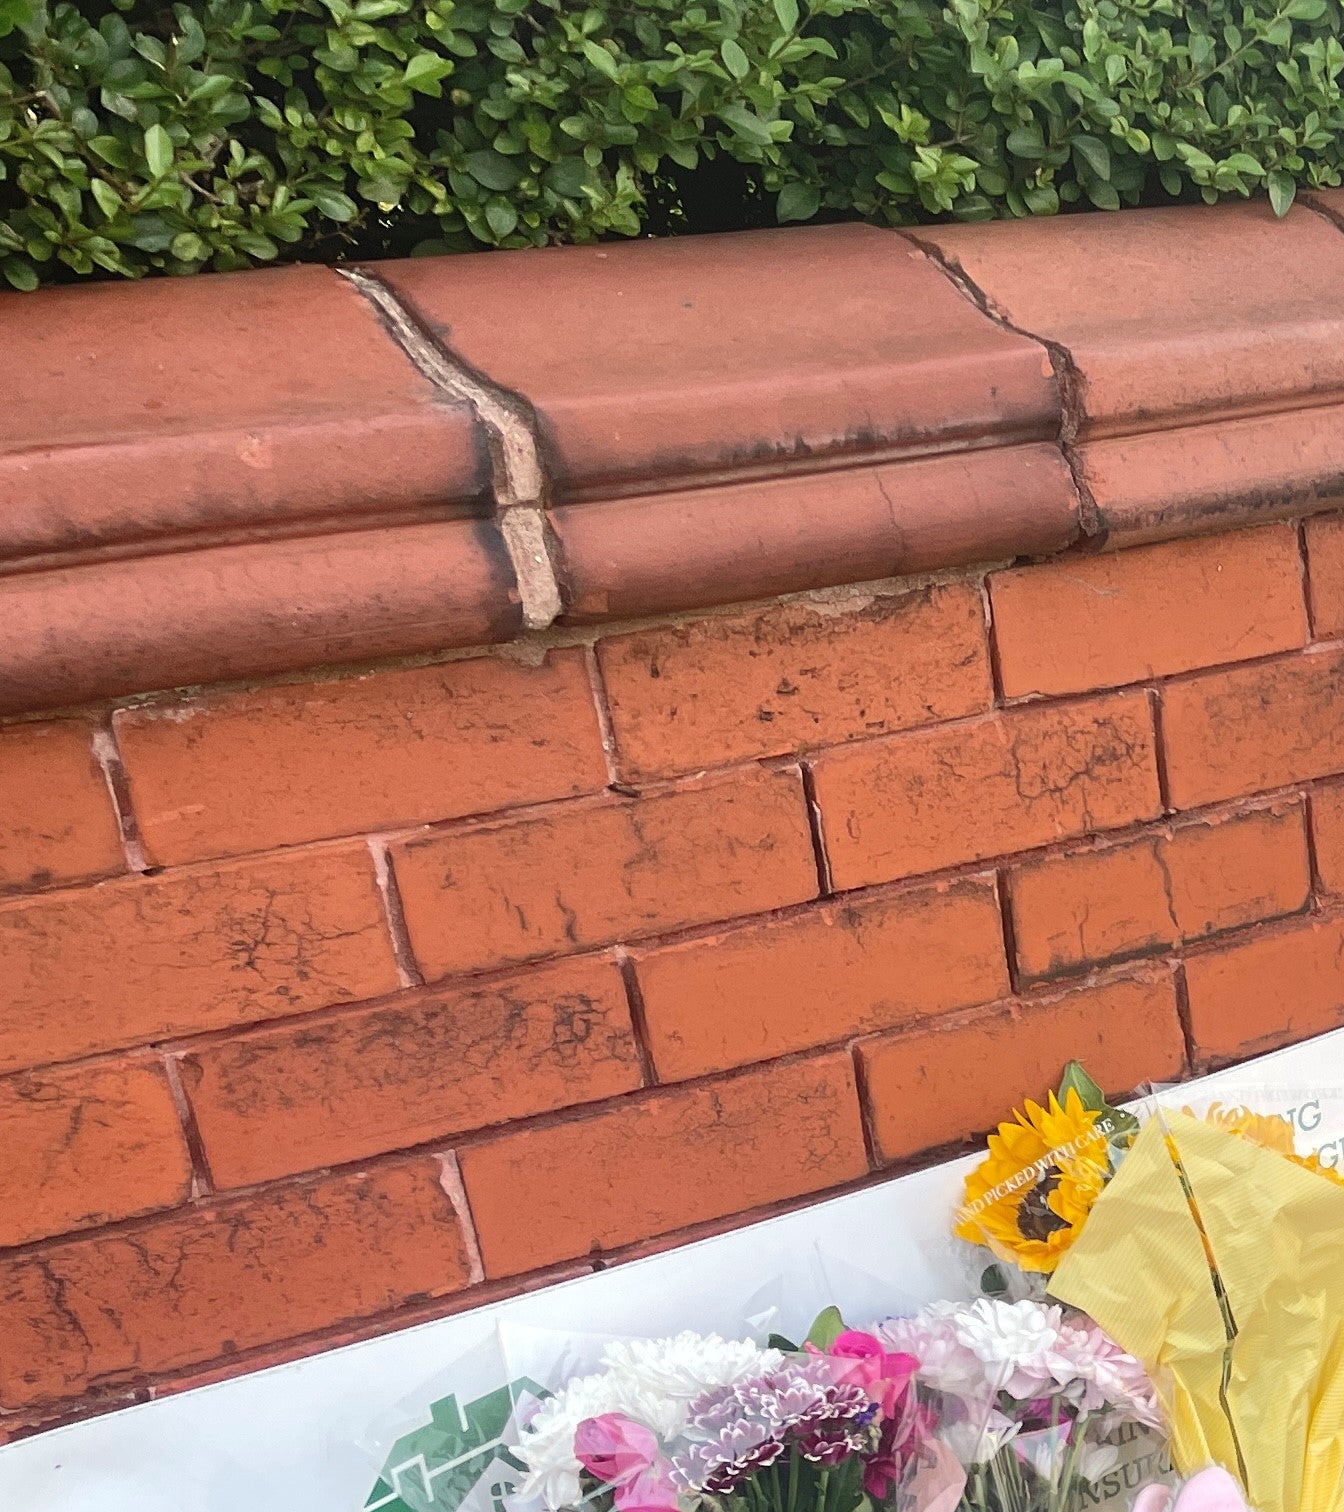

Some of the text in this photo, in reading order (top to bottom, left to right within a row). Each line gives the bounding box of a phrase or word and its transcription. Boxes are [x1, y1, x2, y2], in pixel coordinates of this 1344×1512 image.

[983, 1166, 1038, 1207] PICKED
[1033, 1146, 1076, 1178] WITH
[1074, 1117, 1116, 1152] CARE
